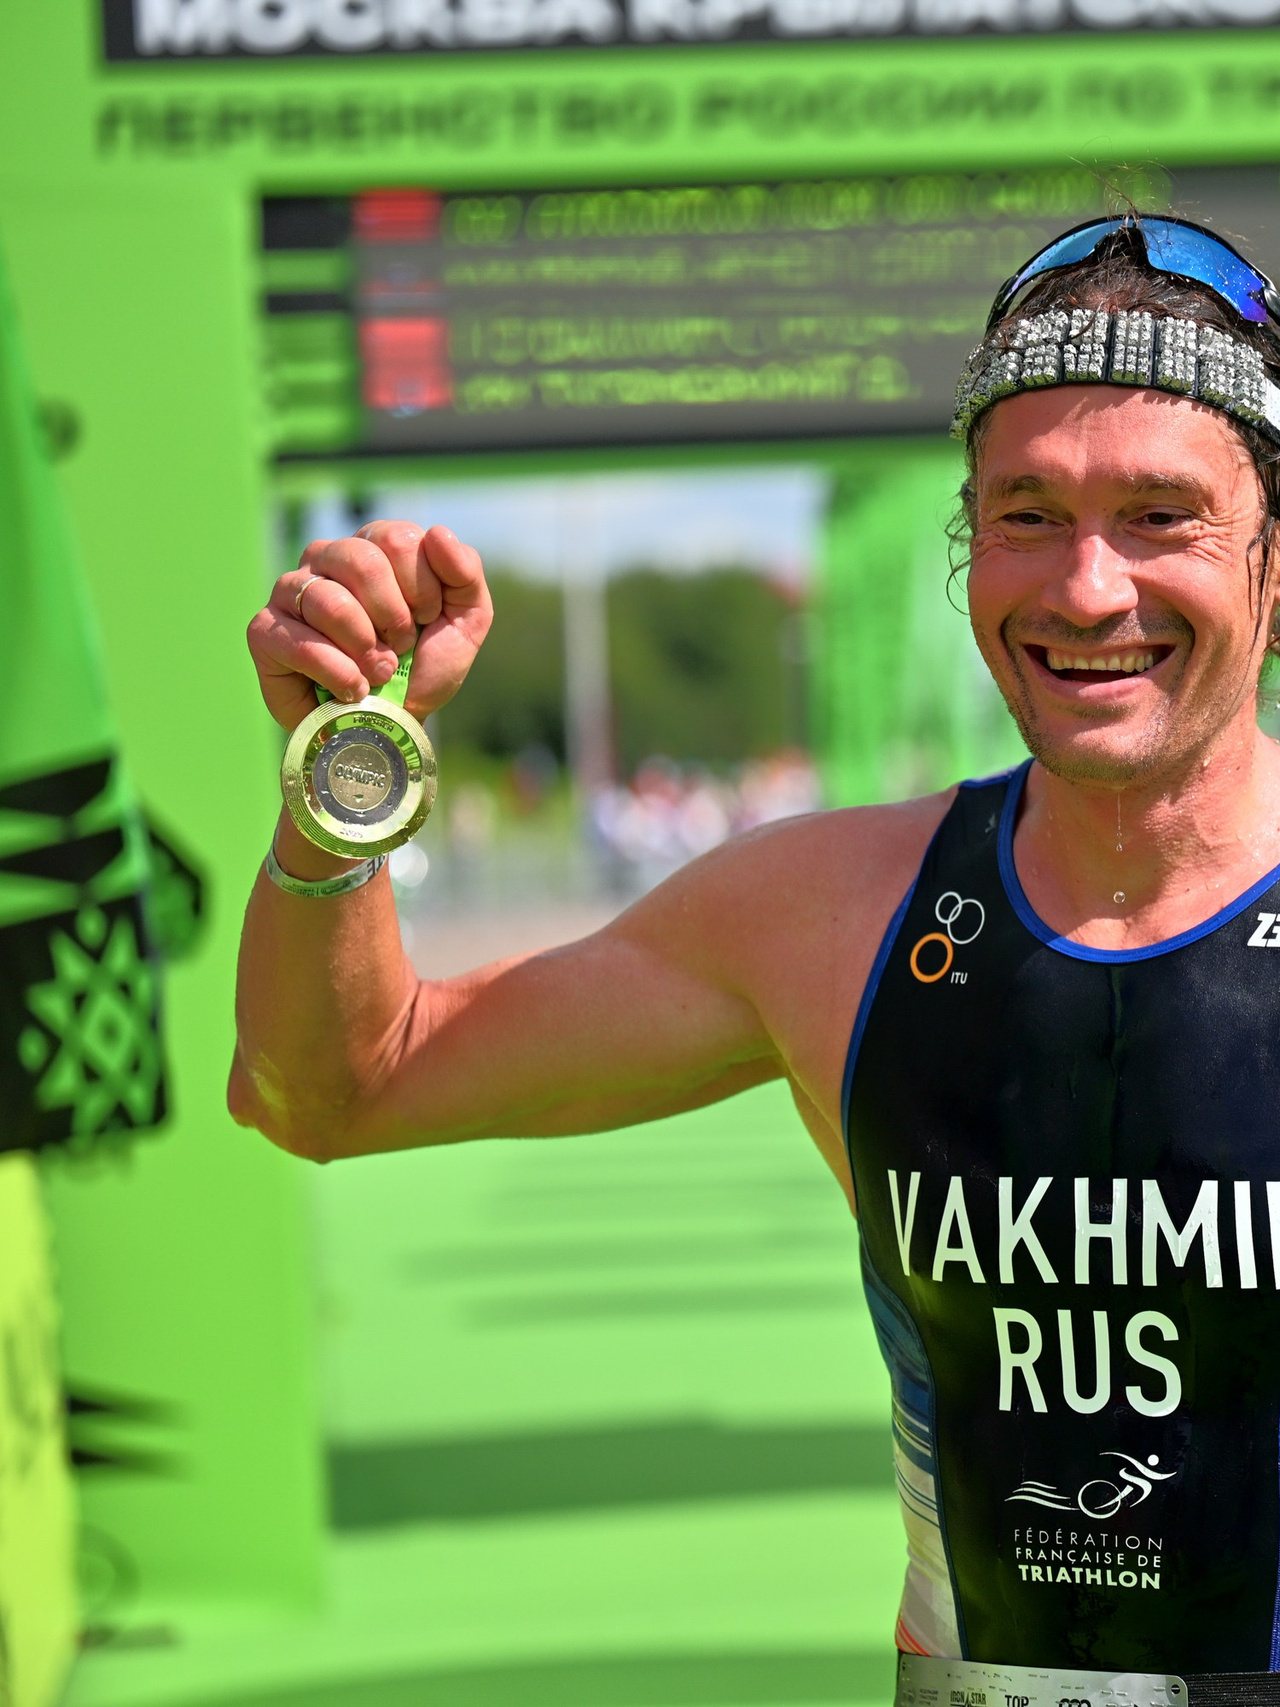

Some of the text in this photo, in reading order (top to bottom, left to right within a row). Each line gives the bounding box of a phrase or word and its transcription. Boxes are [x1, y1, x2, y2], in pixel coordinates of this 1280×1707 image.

[335, 763, 386, 789] OLYMPIC
[950, 971, 968, 985] ITU
[993, 1307, 1182, 1417] RUS
[1014, 1527, 1163, 1551] FÉDÉRATION
[1015, 1547, 1162, 1568] FRANÇAISE DE
[1017, 1564, 1161, 1590] TRIATHLON
